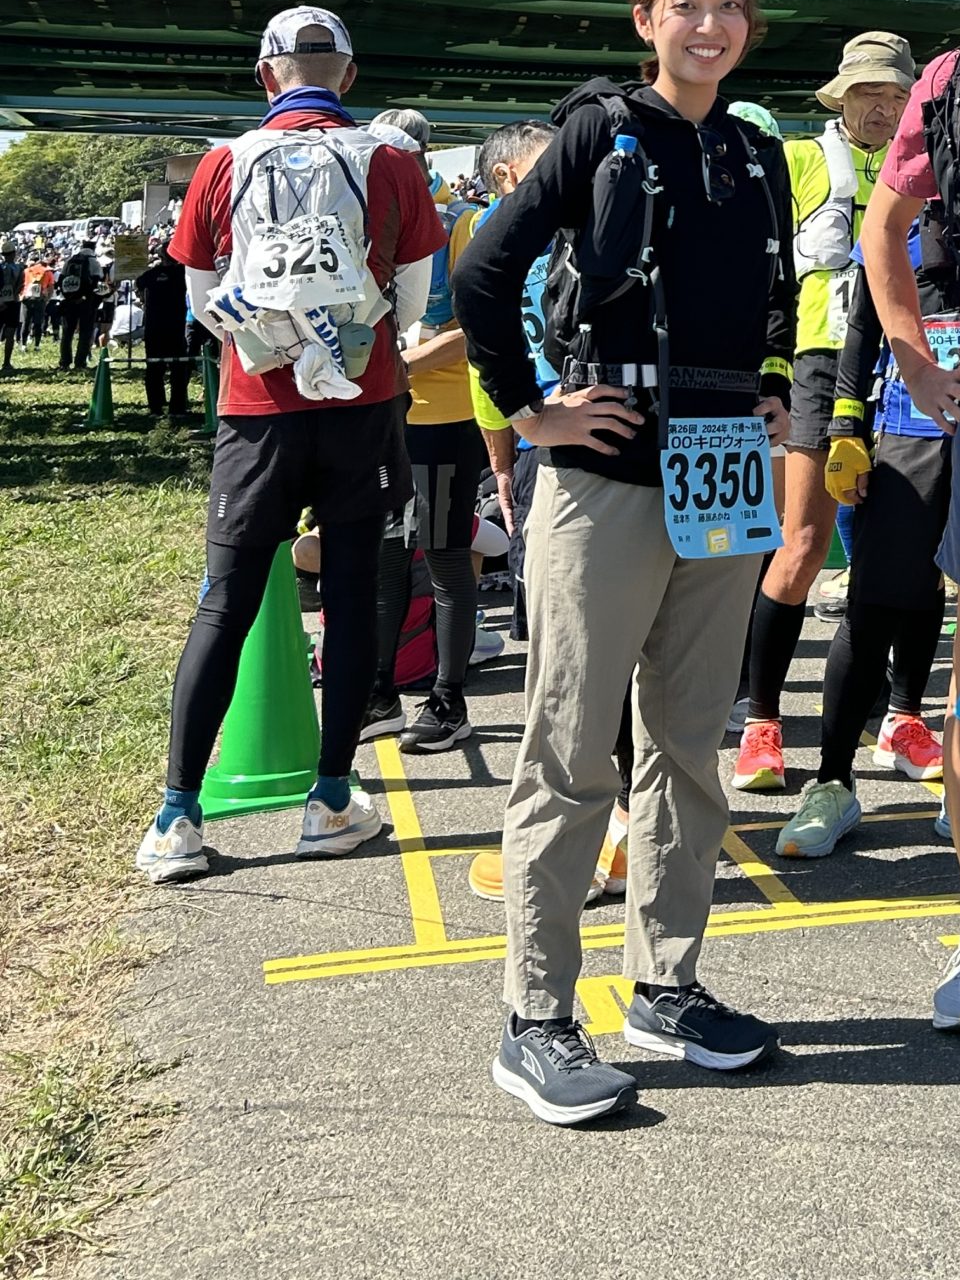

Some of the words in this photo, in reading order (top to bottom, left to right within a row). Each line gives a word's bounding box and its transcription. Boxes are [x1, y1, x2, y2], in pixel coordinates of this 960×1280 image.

[262, 236, 339, 278] 325
[671, 433, 766, 450] 00キロウォーク
[702, 424, 727, 433] 2024年
[667, 450, 764, 511] 3350
